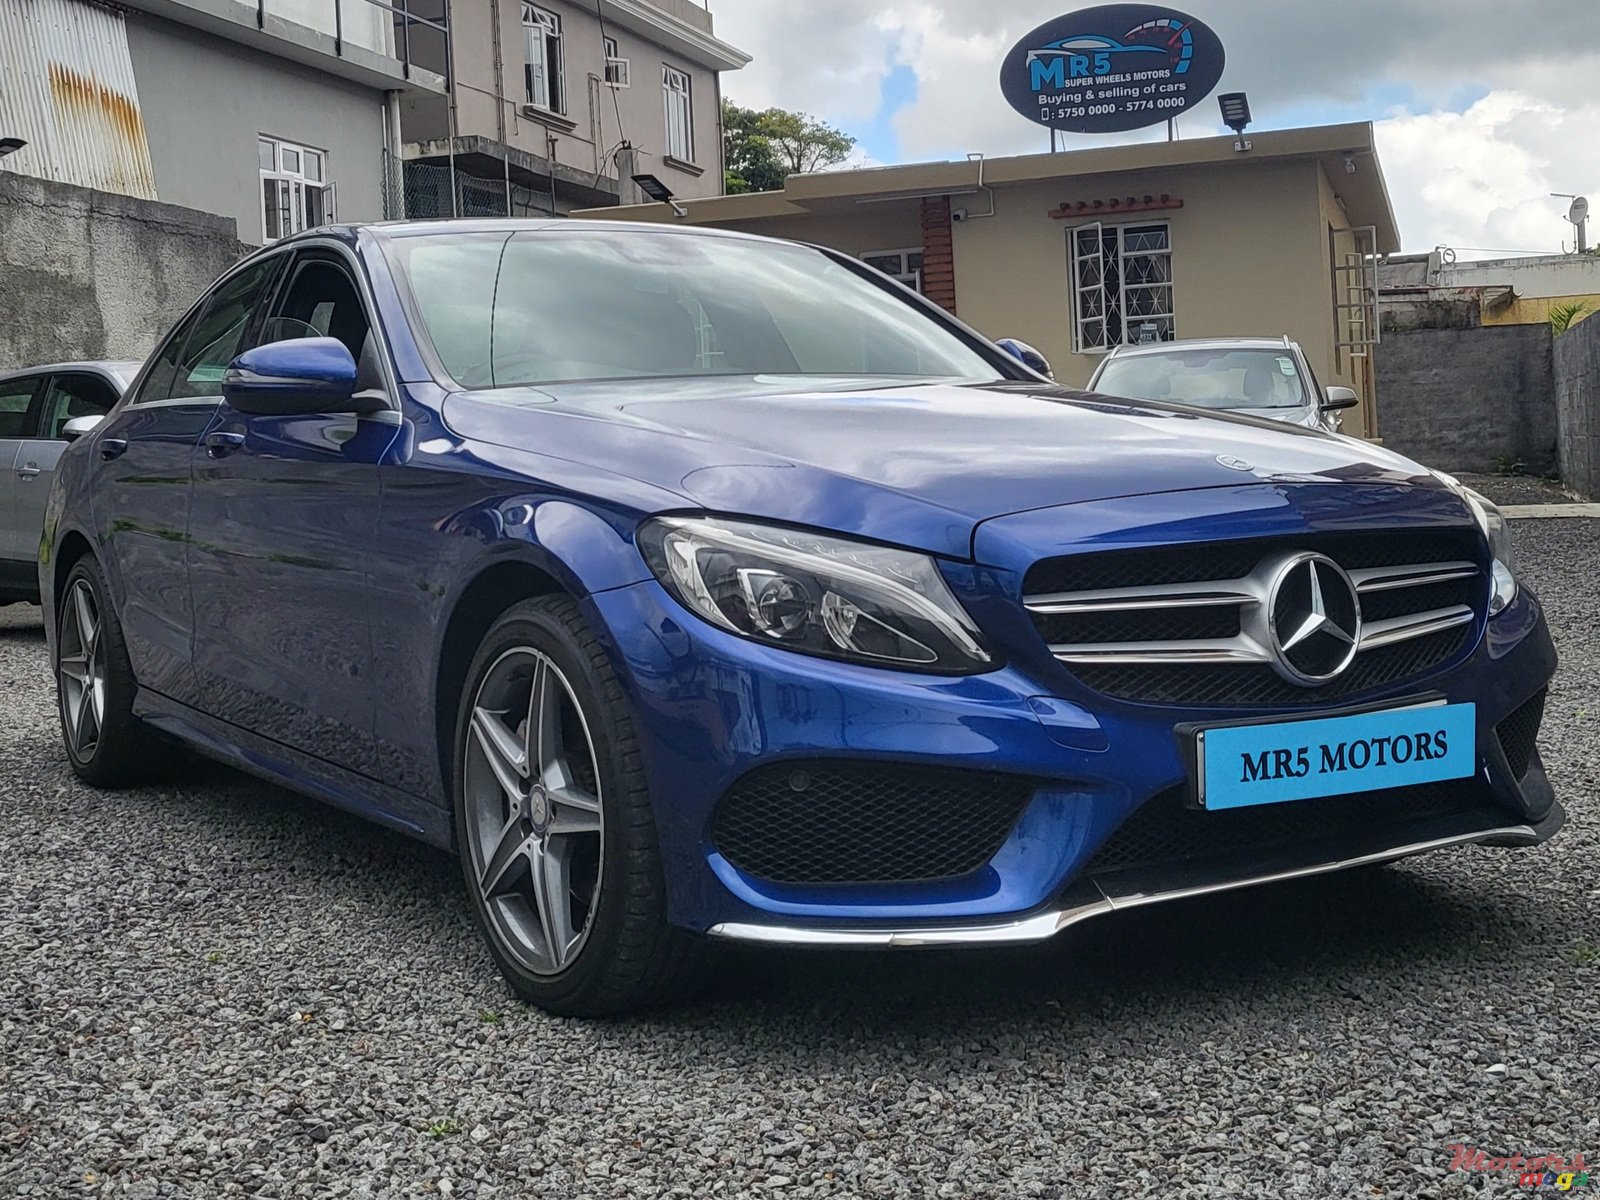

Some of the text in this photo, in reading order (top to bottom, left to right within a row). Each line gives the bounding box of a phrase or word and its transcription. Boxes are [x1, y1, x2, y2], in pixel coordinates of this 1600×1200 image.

[1031, 53, 1111, 91] MR5
[1064, 69, 1171, 88] SUPER WHEELS MOTORS
[1038, 82, 1187, 105] Buying & selling of cars
[1058, 107, 1086, 119] 5750
[1088, 103, 1116, 116] 0000
[1126, 100, 1155, 112] 5774
[1157, 97, 1186, 109] 0000
[1240, 730, 1448, 783] MR5 MOTORS
